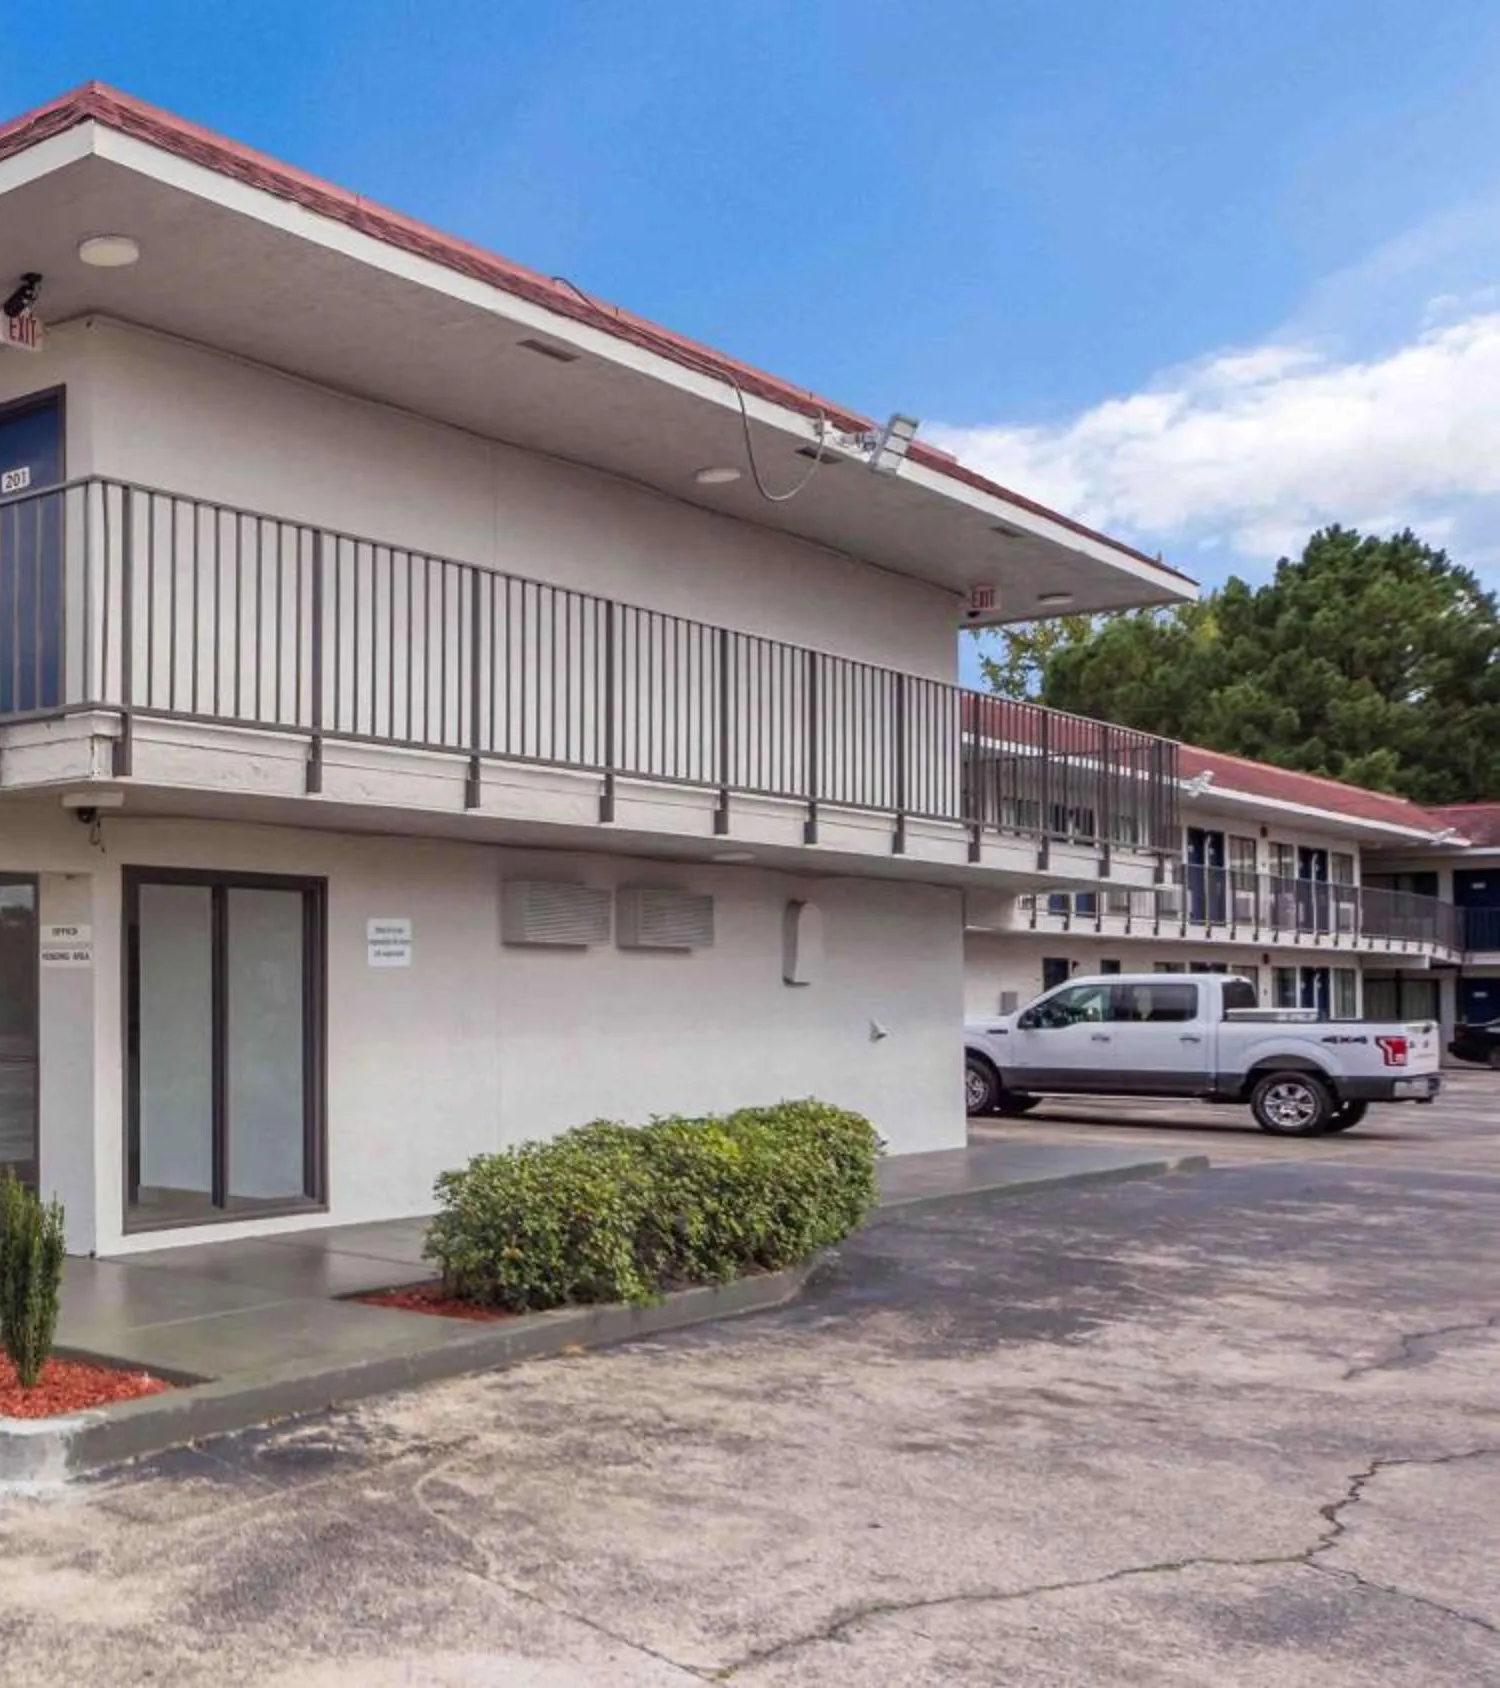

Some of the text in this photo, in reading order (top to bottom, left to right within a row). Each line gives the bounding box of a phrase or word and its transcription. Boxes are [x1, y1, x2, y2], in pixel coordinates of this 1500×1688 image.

[9, 315, 37, 348] EXIT
[5, 471, 27, 488] 201
[971, 589, 996, 608] EXIT
